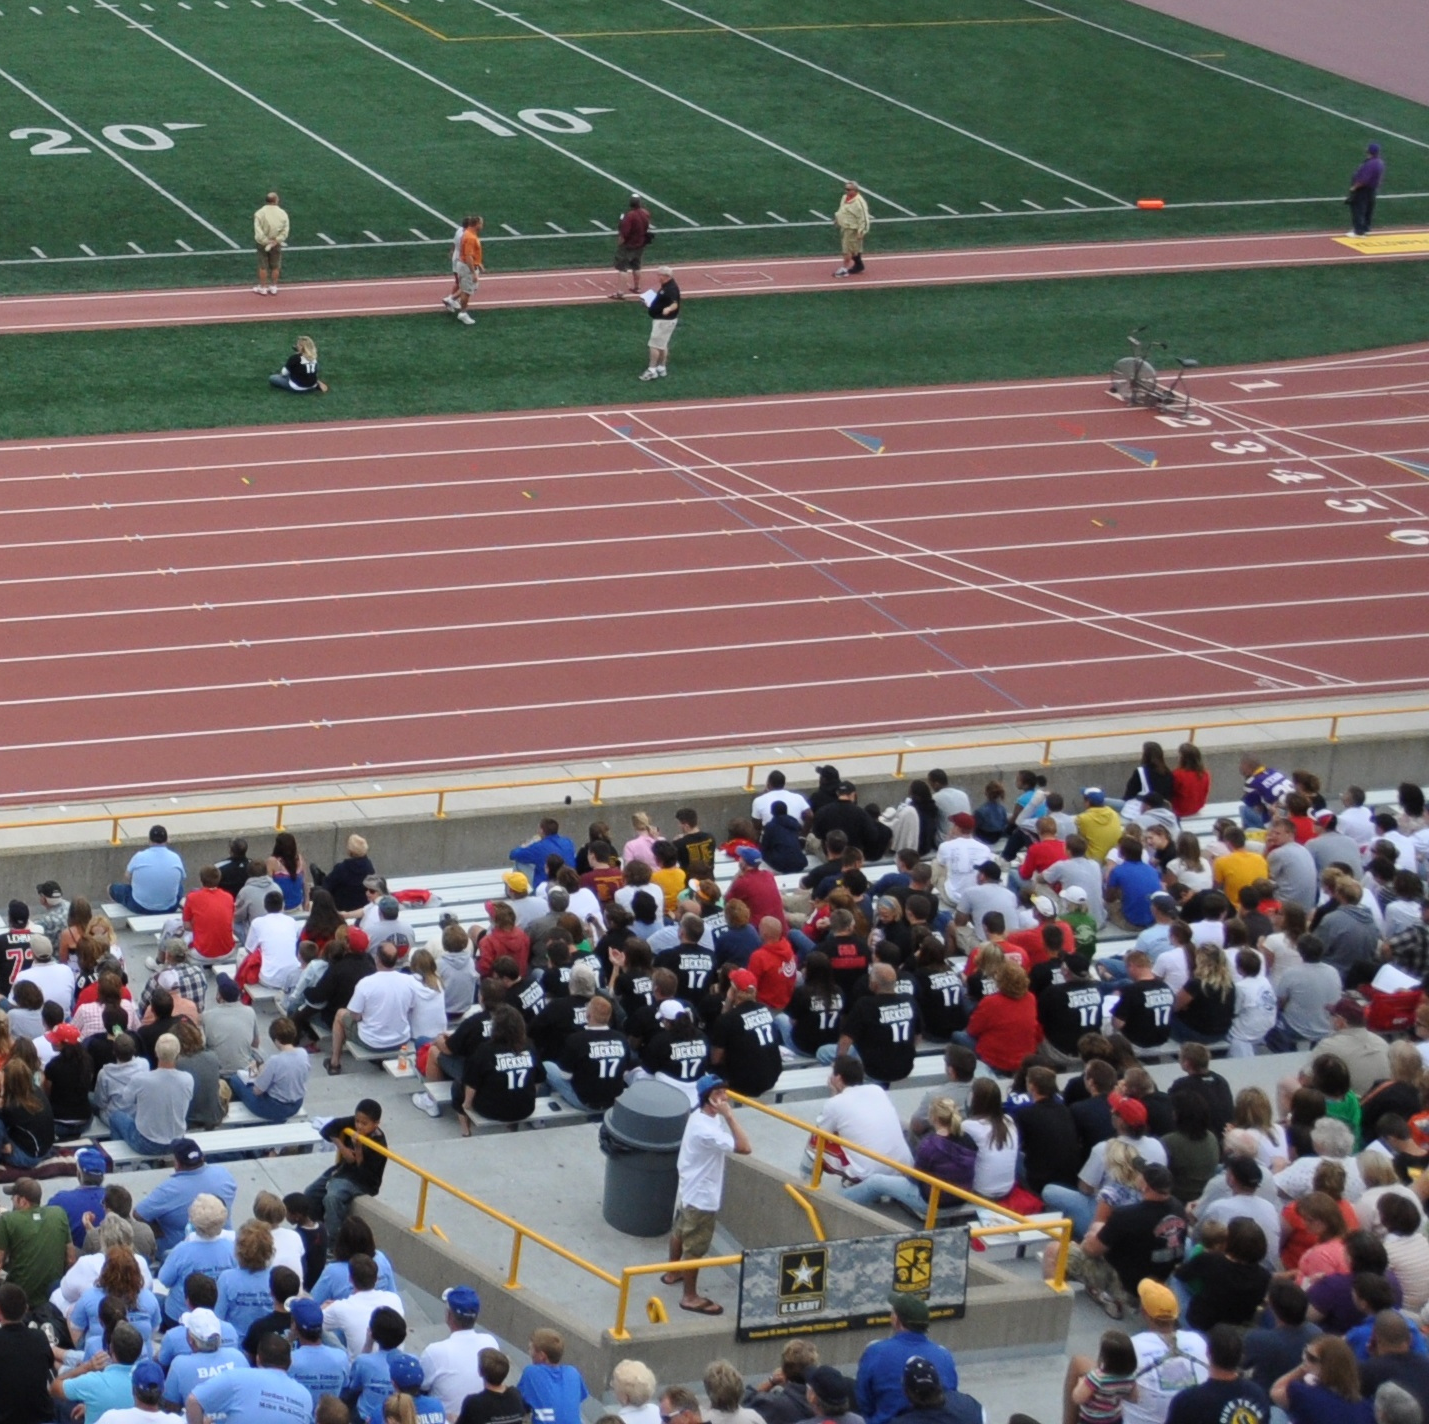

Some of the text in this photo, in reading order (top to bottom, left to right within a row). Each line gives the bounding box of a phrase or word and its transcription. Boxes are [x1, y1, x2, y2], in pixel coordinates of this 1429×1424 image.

[447, 108, 594, 138] 10
[8, 122, 177, 156] 20
[1209, 440, 1268, 455] 3
[1266, 468, 1326, 485] 4
[1324, 498, 1390, 514] 5
[681, 958, 712, 971] JACKSON
[687, 970, 706, 989] 17
[942, 985, 960, 1007] 17
[1068, 991, 1102, 1009] JACKSON
[1144, 991, 1175, 1008] JACKSON
[743, 1009, 774, 1031] JACKSON
[879, 1006, 914, 1024] JACKSON
[1079, 1004, 1099, 1027] 17
[1154, 1004, 1171, 1027] 17
[754, 1023, 774, 1046] 17
[891, 1020, 910, 1043] 17
[589, 1045, 625, 1059] JACKSON
[670, 1043, 706, 1060] JACKSON
[495, 1054, 533, 1072] JACKSON
[599, 1058, 621, 1078] 17
[681, 1058, 701, 1079] 17
[506, 1068, 525, 1090] 17
